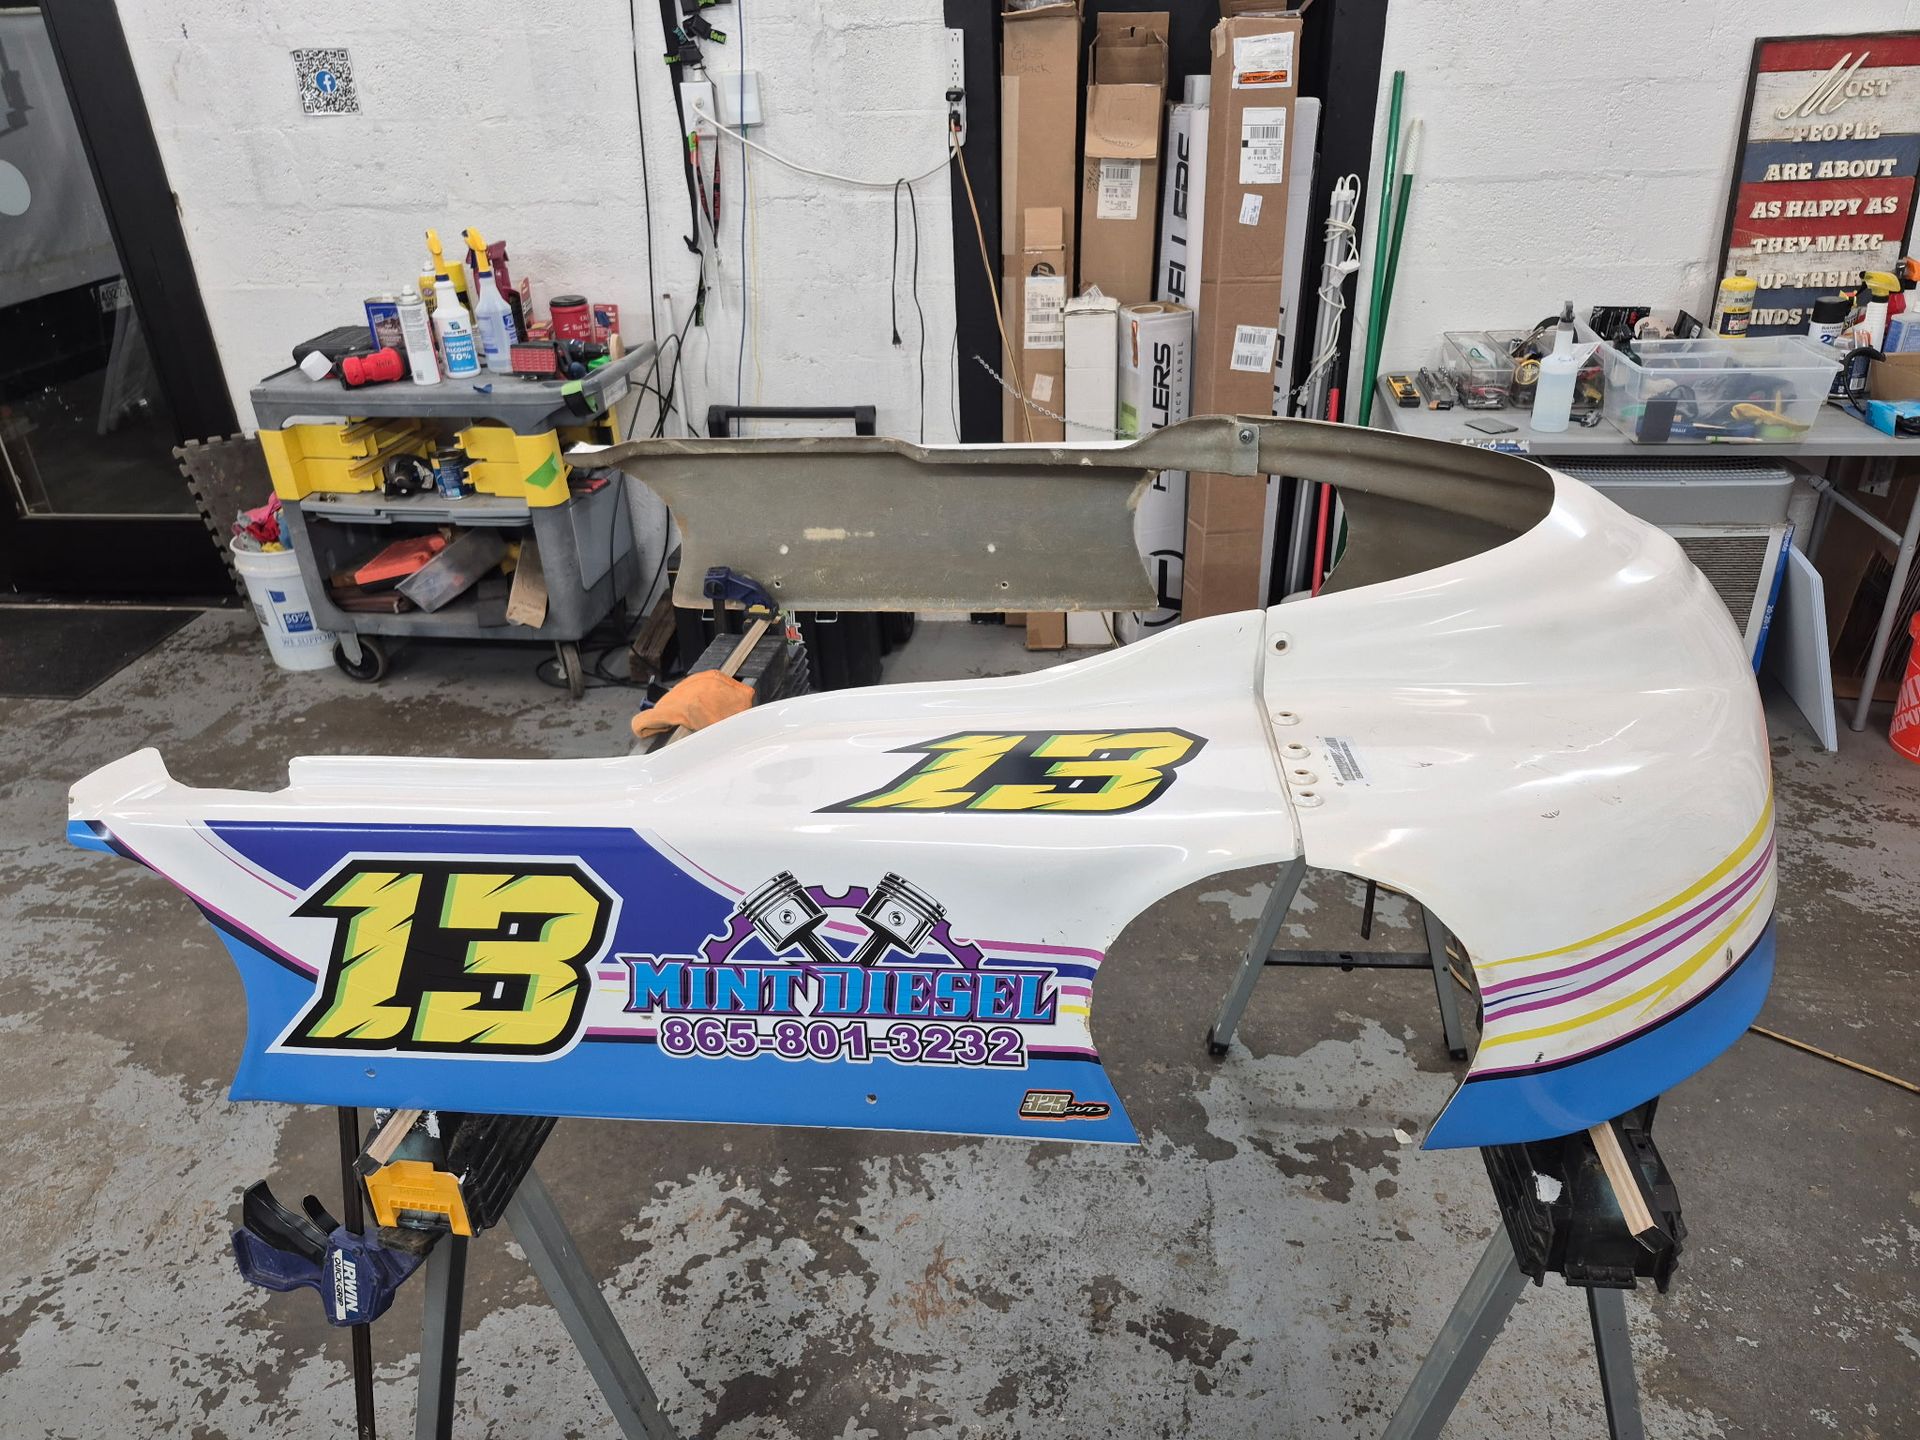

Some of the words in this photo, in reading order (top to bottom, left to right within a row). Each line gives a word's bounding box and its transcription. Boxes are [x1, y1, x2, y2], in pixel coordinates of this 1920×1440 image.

[1792, 122, 1881, 142] PEOPLE
[1764, 162, 1813, 181] ARE
[1816, 159, 1897, 178] ABOUT
[1750, 201, 1781, 218] AS
[1785, 198, 1862, 217] HAPPY
[1864, 196, 1898, 214] AS
[1752, 236, 1813, 254] THEY
[1816, 234, 1884, 252] MAKE
[1758, 272, 1787, 289] UP
[1794, 271, 1862, 289] THEIR
[1750, 309, 1802, 325] INDS
[450, 353, 472, 361] 70%
[828, 728, 1204, 813] 13
[288, 864, 602, 1050] 13
[626, 959, 803, 1012] MINT
[809, 966, 1059, 1023] DIESEL
[661, 1019, 1025, 1063] 865-801-3232
[1020, 1092, 1072, 1115] 325
[343, 1259, 358, 1313] IRWIN
